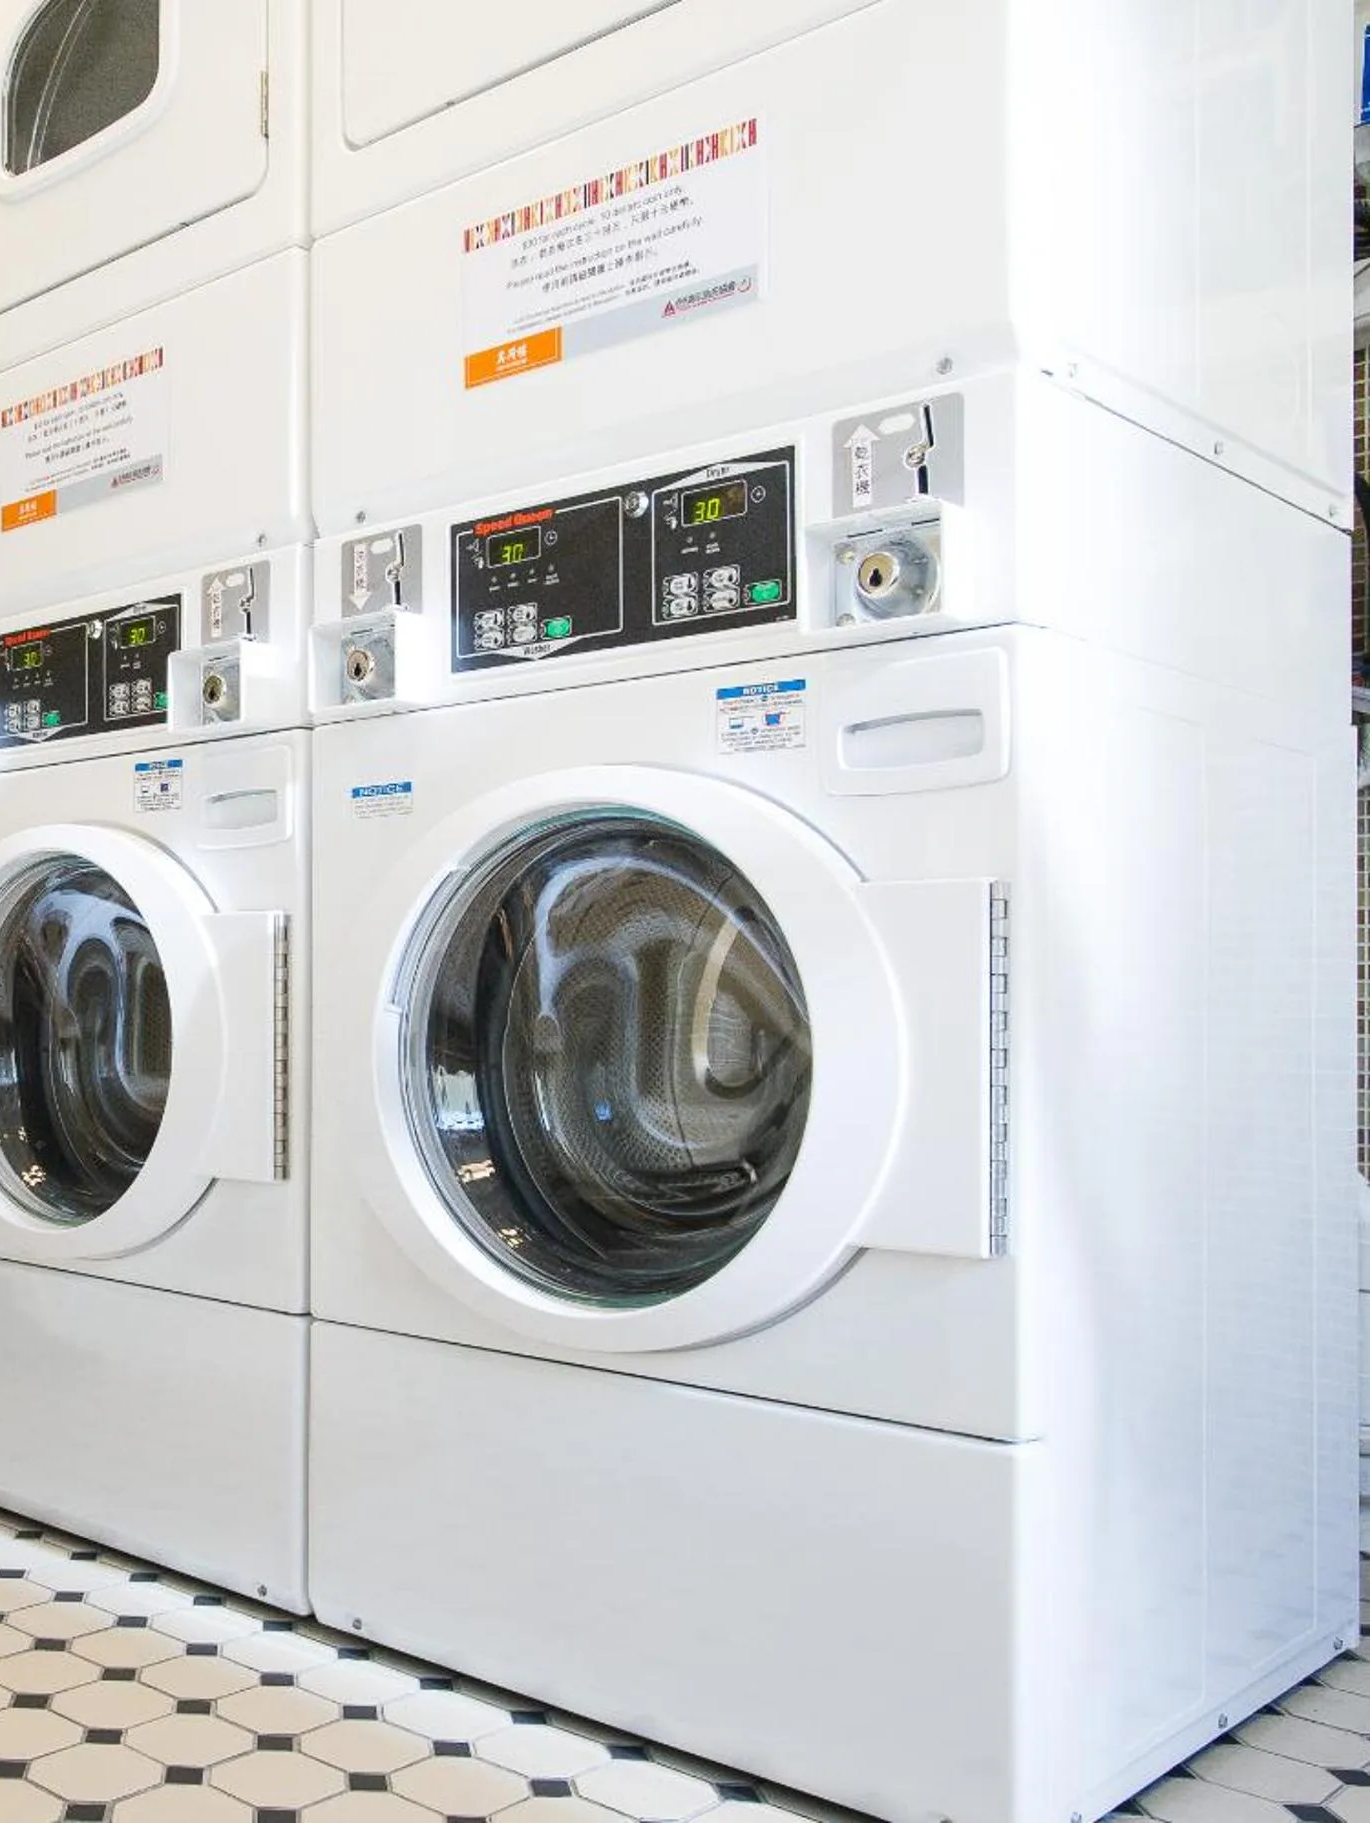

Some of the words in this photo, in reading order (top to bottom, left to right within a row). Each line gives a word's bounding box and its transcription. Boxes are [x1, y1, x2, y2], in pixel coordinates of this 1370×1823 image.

[695, 498, 720, 522] 30
[476, 514, 512, 537] Speed
[502, 543, 524, 565] 30
